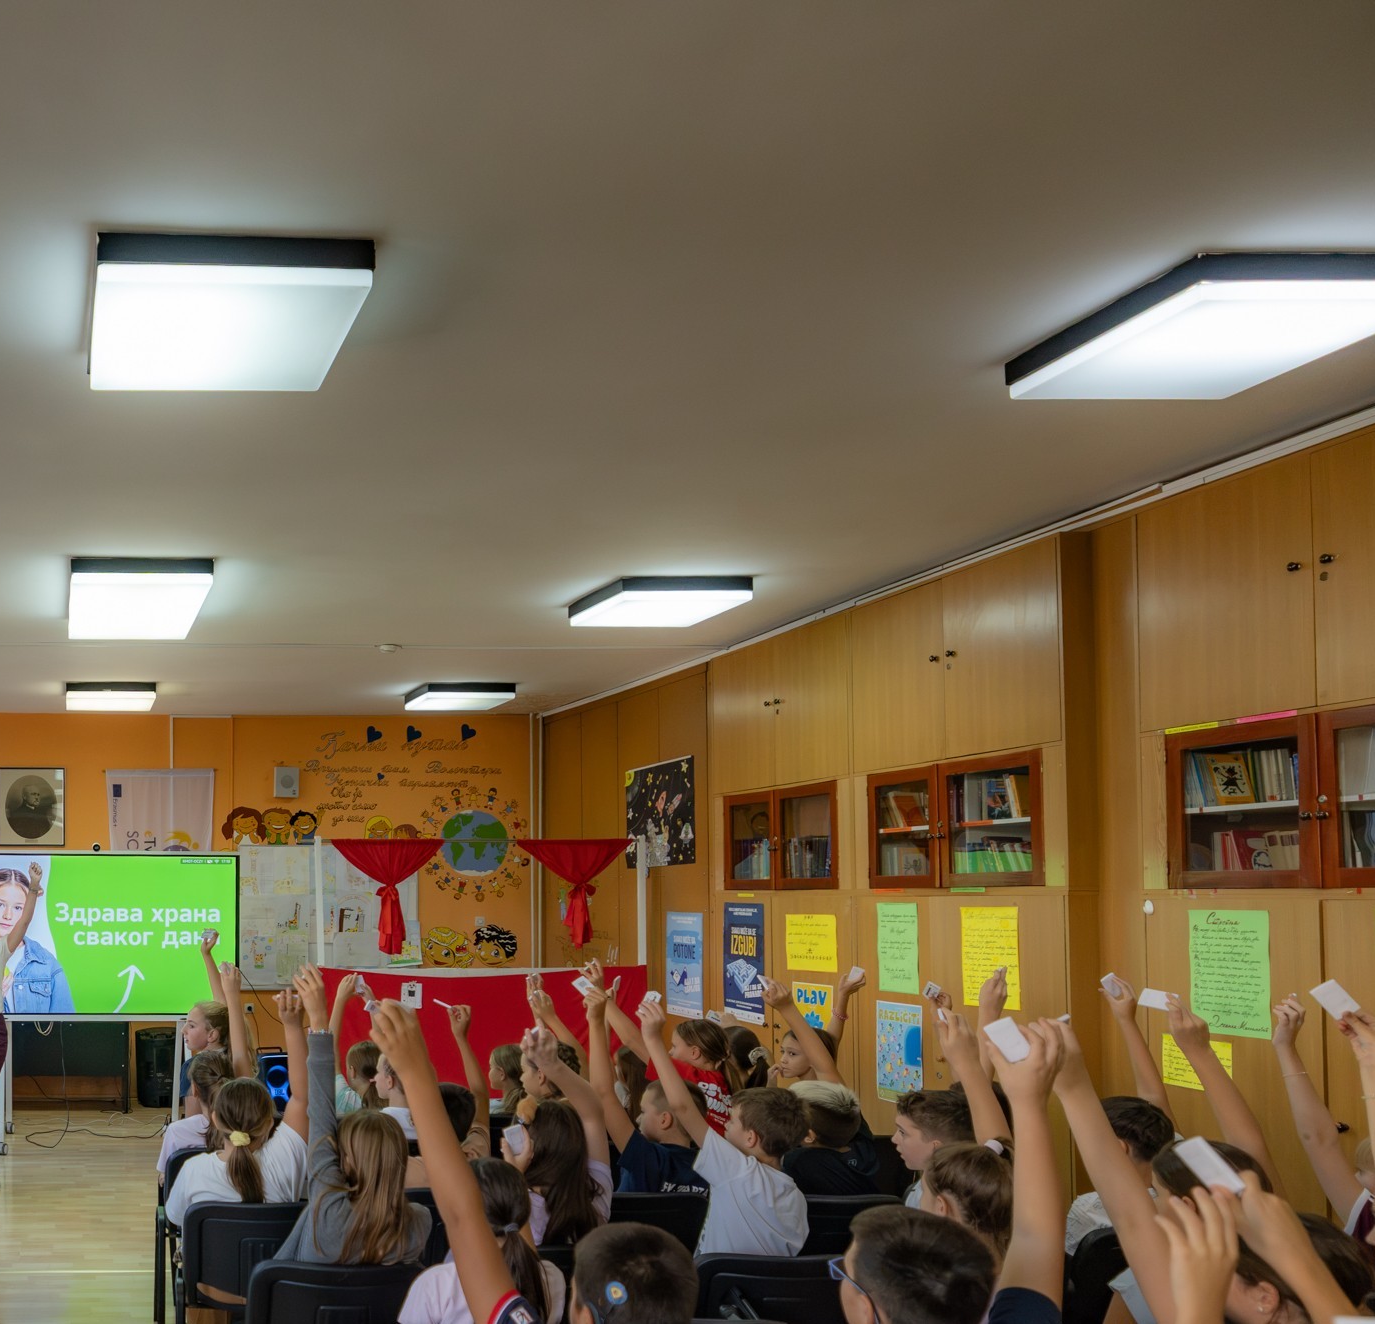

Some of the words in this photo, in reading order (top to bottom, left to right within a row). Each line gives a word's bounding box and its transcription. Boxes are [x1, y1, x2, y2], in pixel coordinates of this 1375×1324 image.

[55, 902, 143, 927] Здрава
[151, 907, 221, 927] храна
[73, 930, 154, 945] сваког
[161, 930, 221, 949] дан
[730, 934, 757, 957] IZGUBI
[673, 943, 696, 960] POTONE
